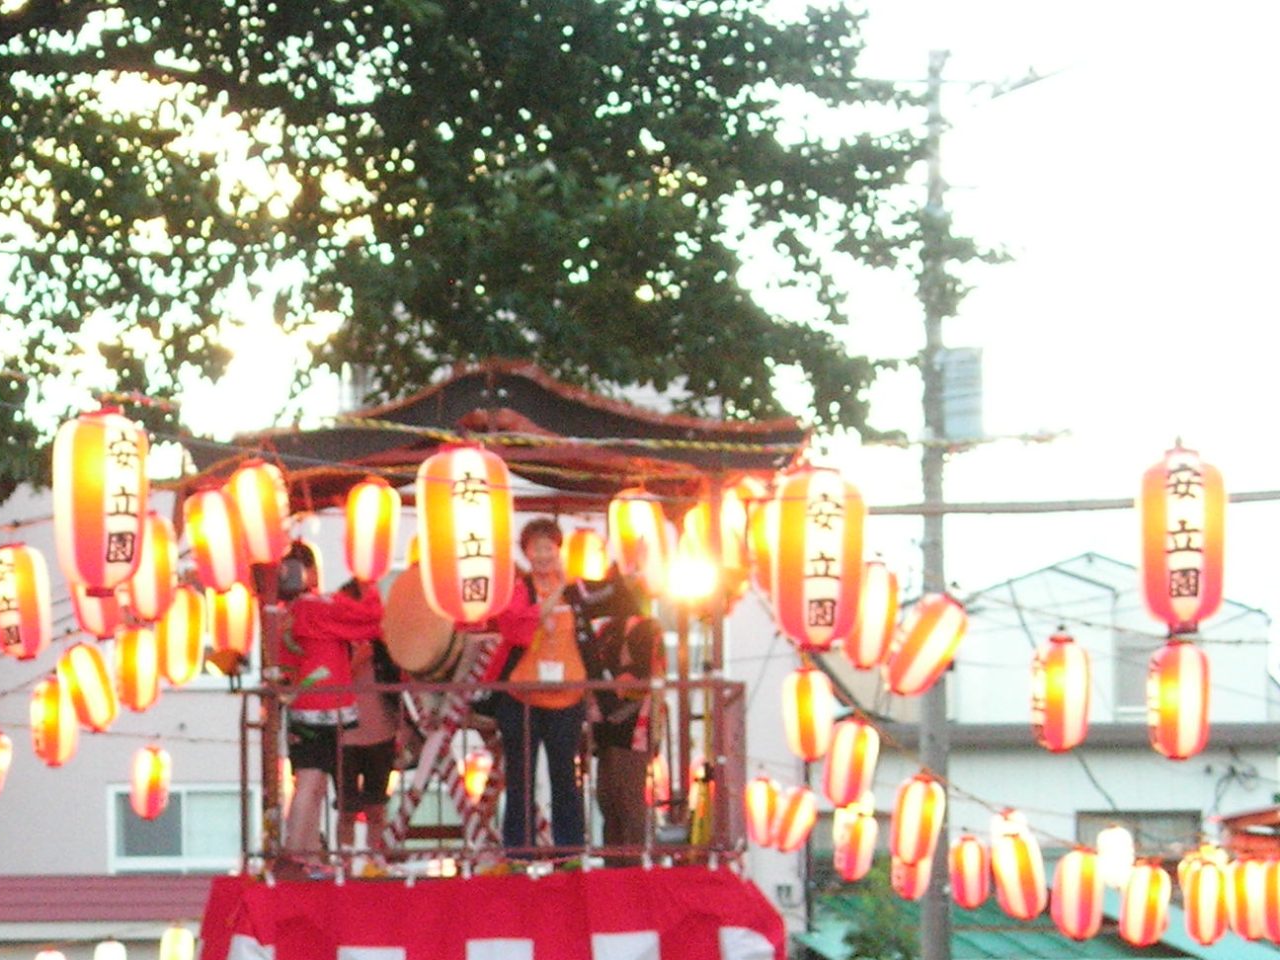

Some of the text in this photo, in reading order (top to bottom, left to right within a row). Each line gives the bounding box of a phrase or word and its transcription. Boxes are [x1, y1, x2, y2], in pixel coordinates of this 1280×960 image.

[106, 431, 139, 564] 安立園
[453, 471, 492, 603] 安立園
[804, 492, 844, 628] 安立園
[1166, 463, 1204, 599] 安立園
